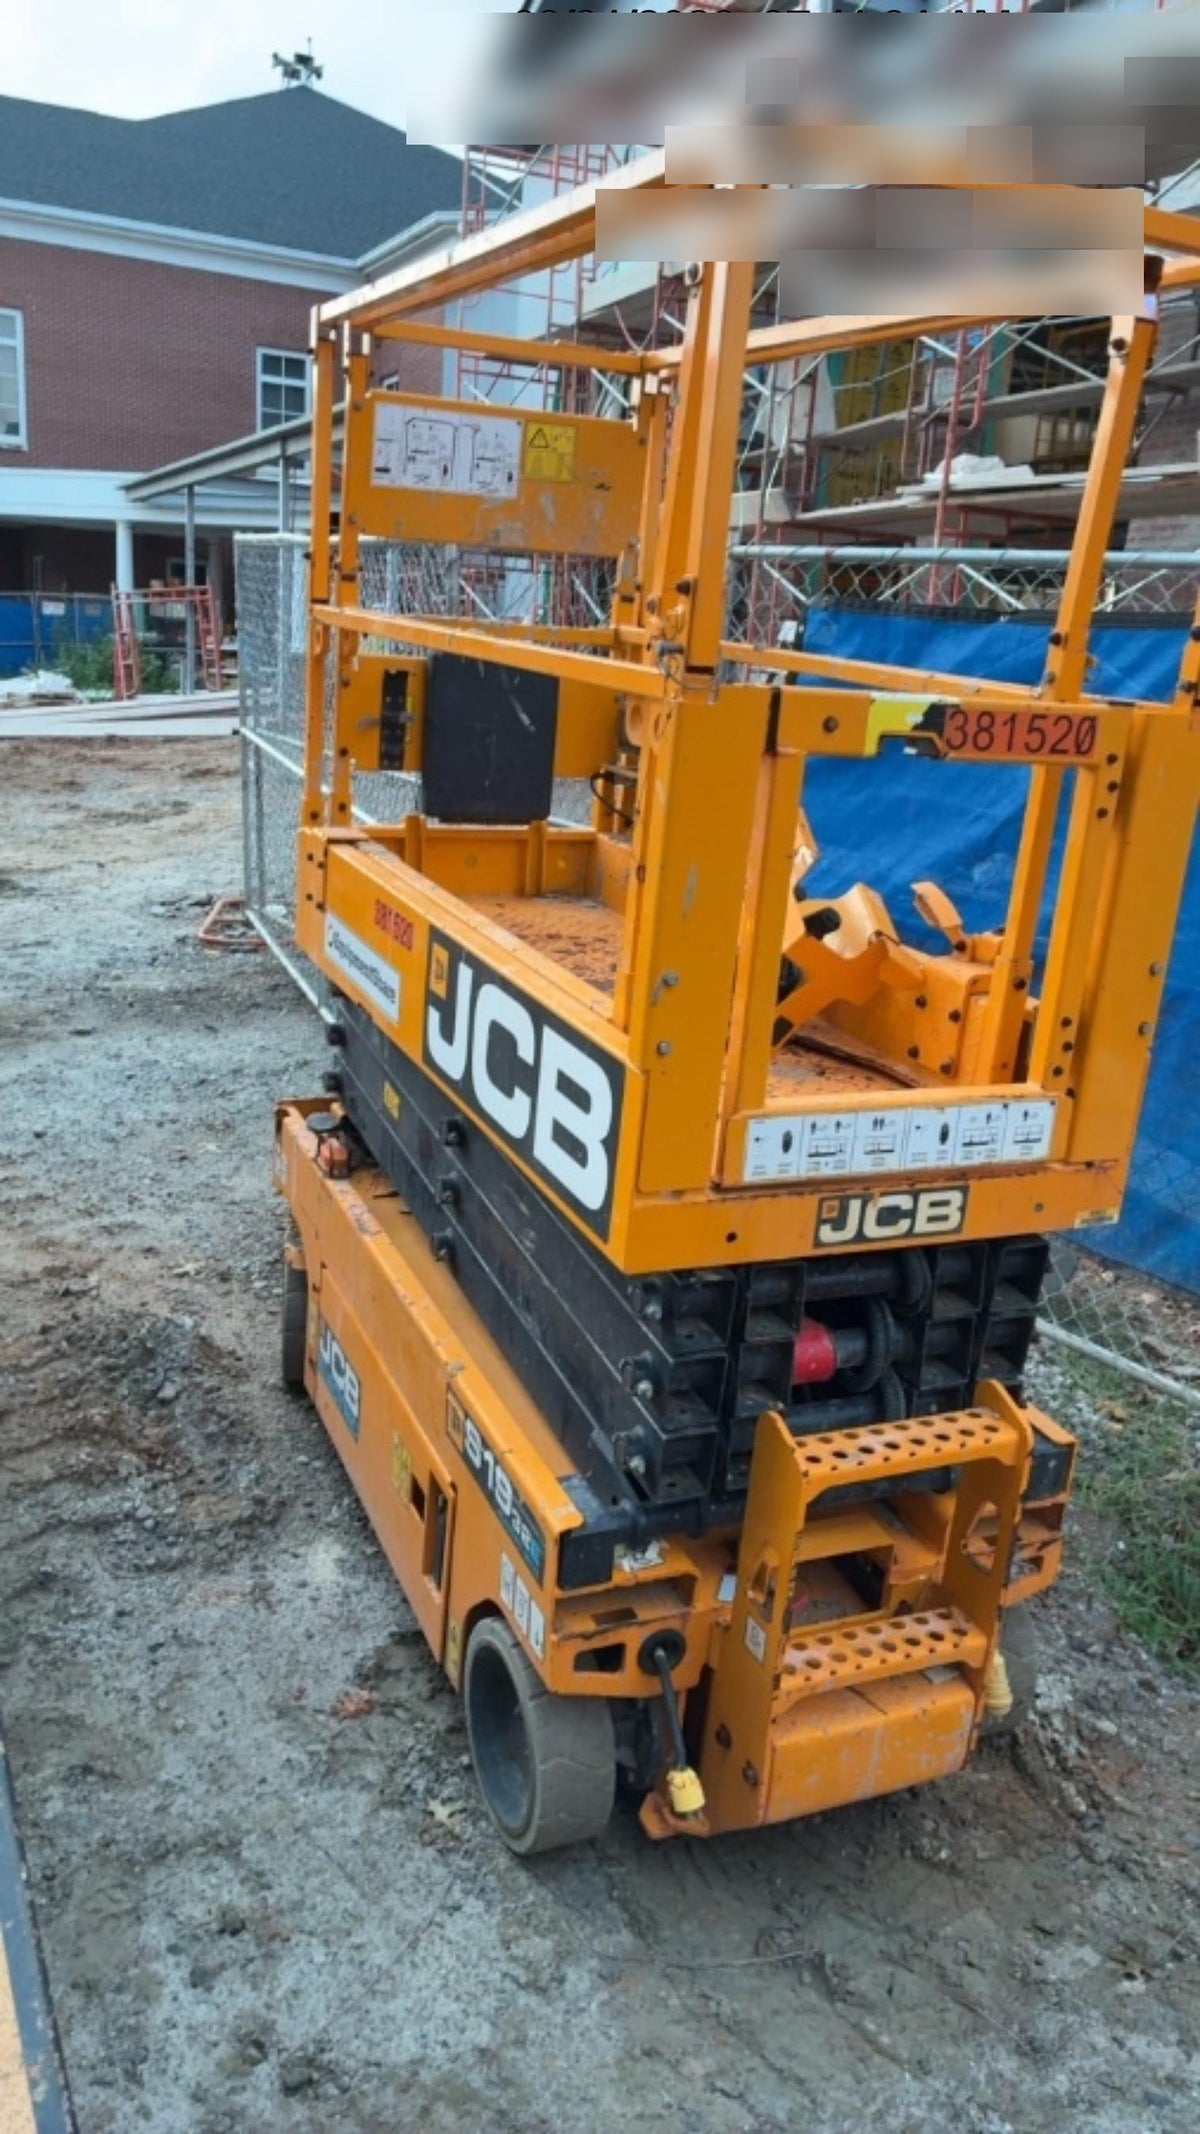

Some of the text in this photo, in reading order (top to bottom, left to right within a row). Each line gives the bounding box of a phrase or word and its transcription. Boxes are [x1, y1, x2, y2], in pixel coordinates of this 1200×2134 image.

[946, 711, 1096, 755] 381520
[427, 962, 613, 1212] JCB
[819, 1190, 963, 1243] JCB
[320, 1328, 359, 1419] JCB
